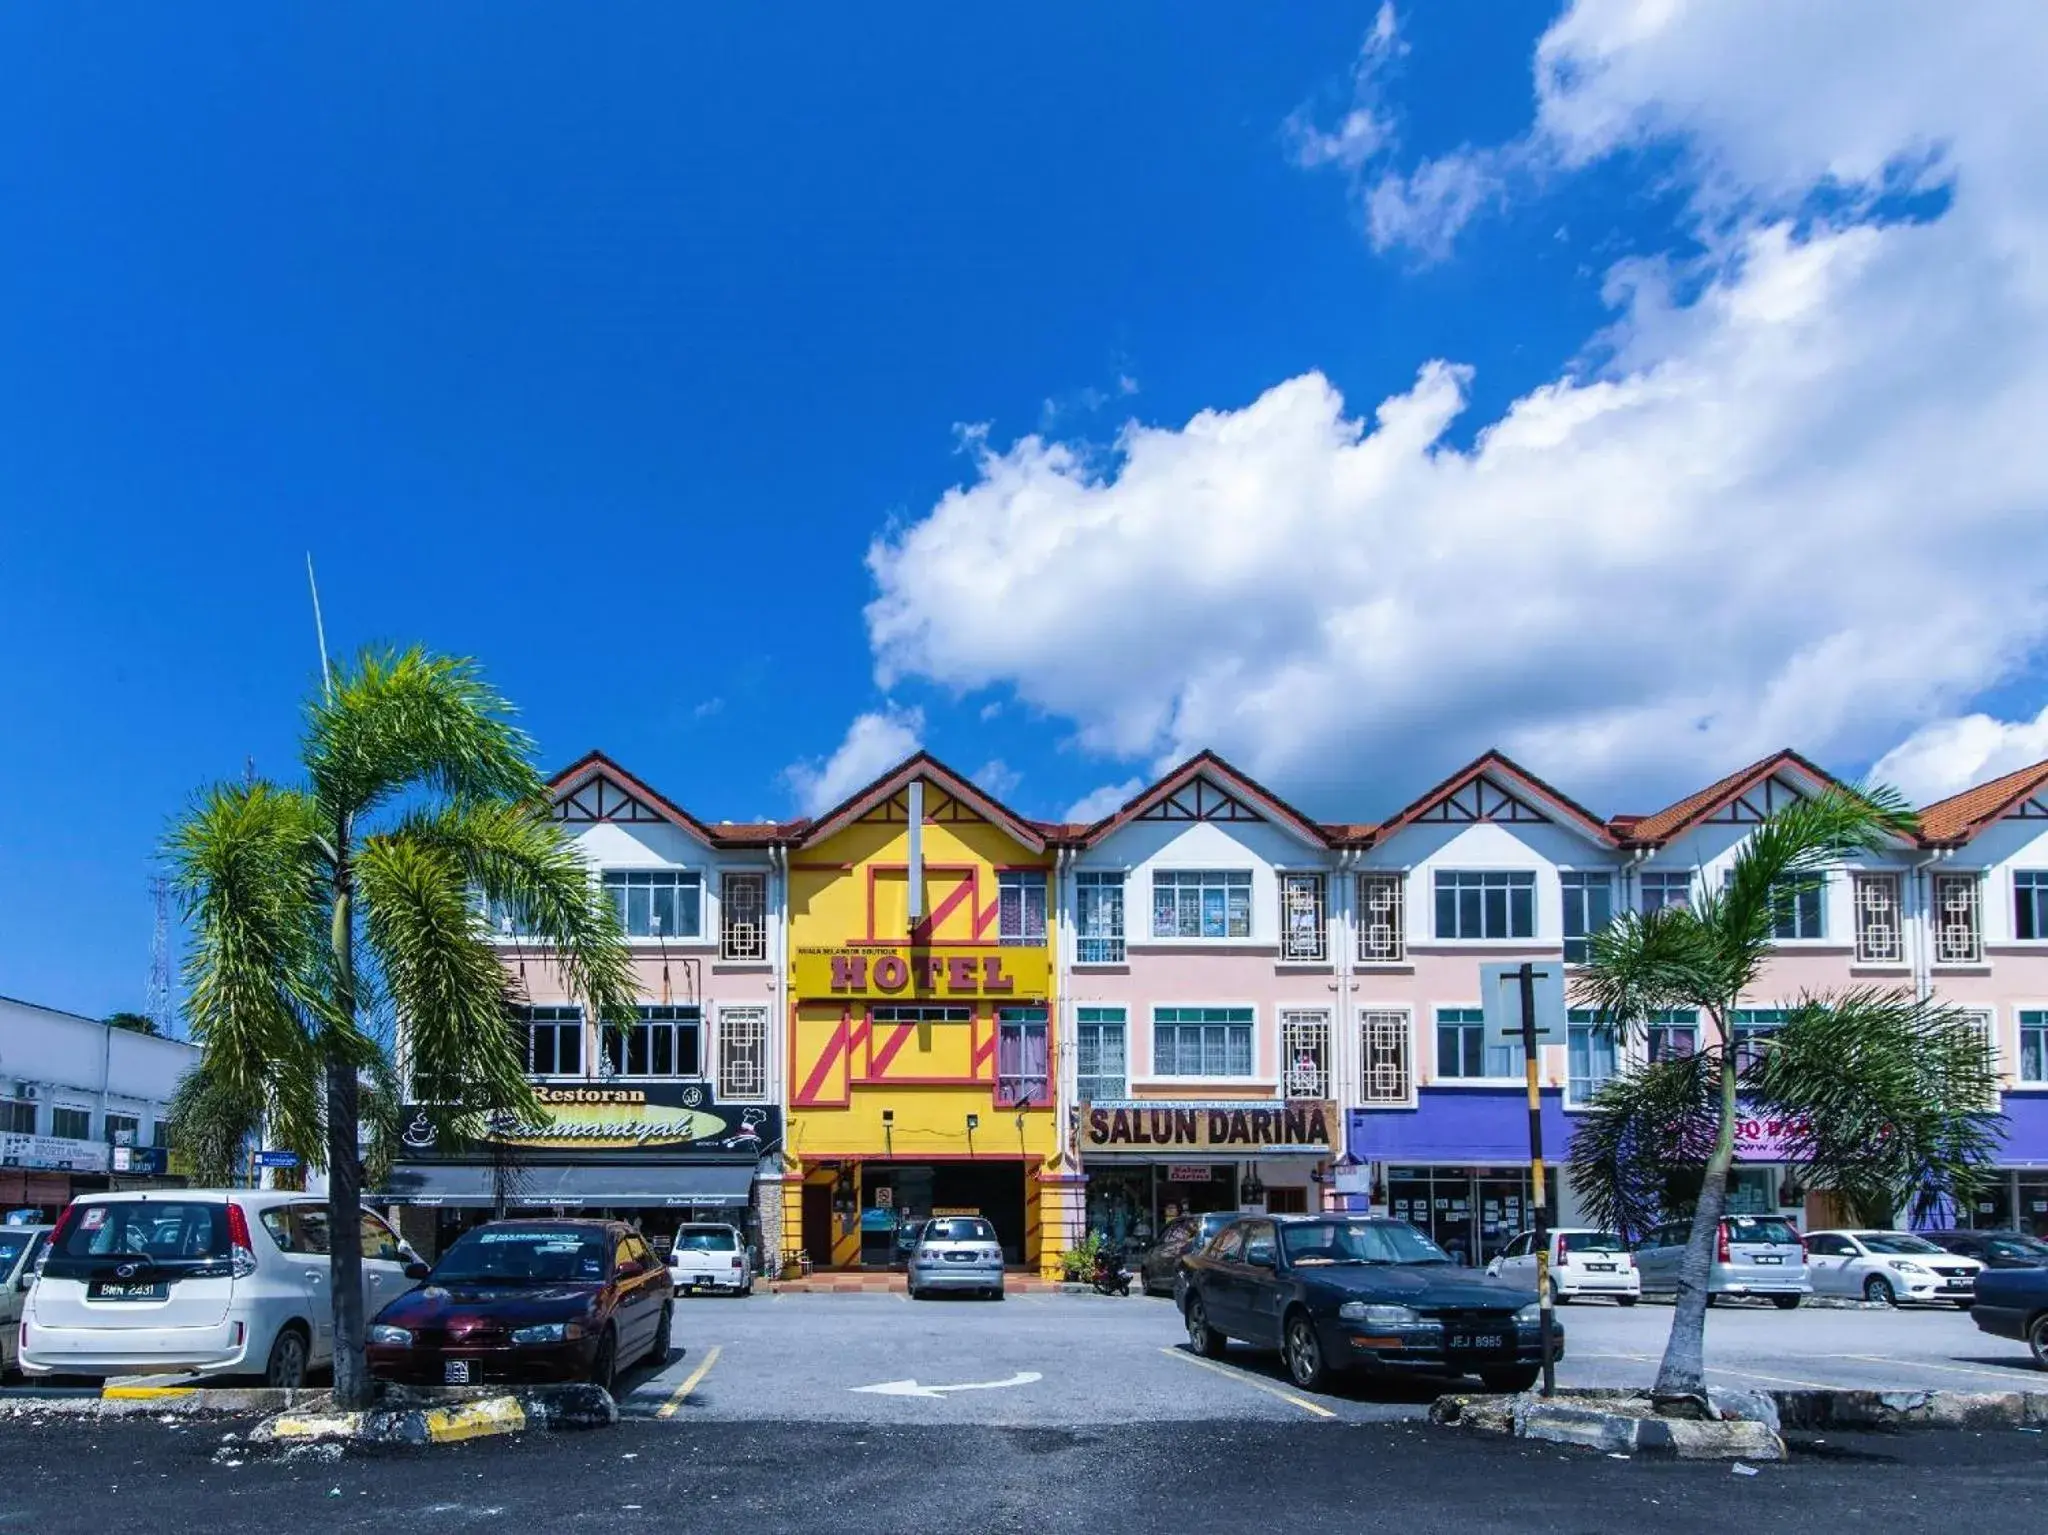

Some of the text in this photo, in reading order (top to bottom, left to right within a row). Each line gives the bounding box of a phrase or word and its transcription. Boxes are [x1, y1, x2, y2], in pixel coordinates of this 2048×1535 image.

[831, 956, 1013, 992] HOTEL
[531, 1086, 645, 1102] Restoran
[1090, 1108, 1329, 1145] SALUN DARINA
